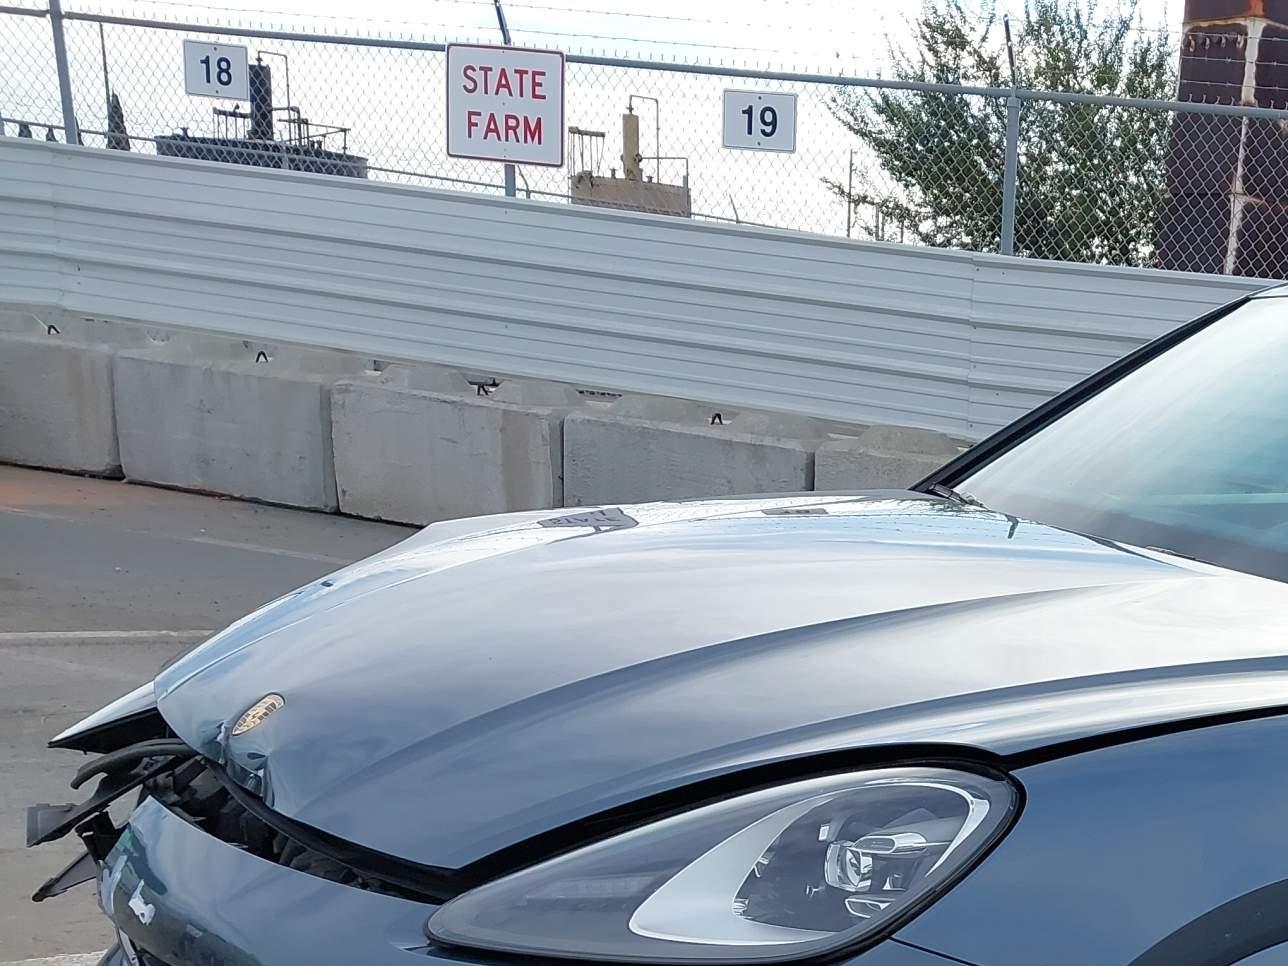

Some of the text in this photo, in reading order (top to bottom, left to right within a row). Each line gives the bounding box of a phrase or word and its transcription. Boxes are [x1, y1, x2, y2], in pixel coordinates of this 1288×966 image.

[199, 55, 233, 87] 18
[463, 65, 547, 100] STATE
[467, 111, 542, 145] FARM
[741, 104, 778, 137] 19
